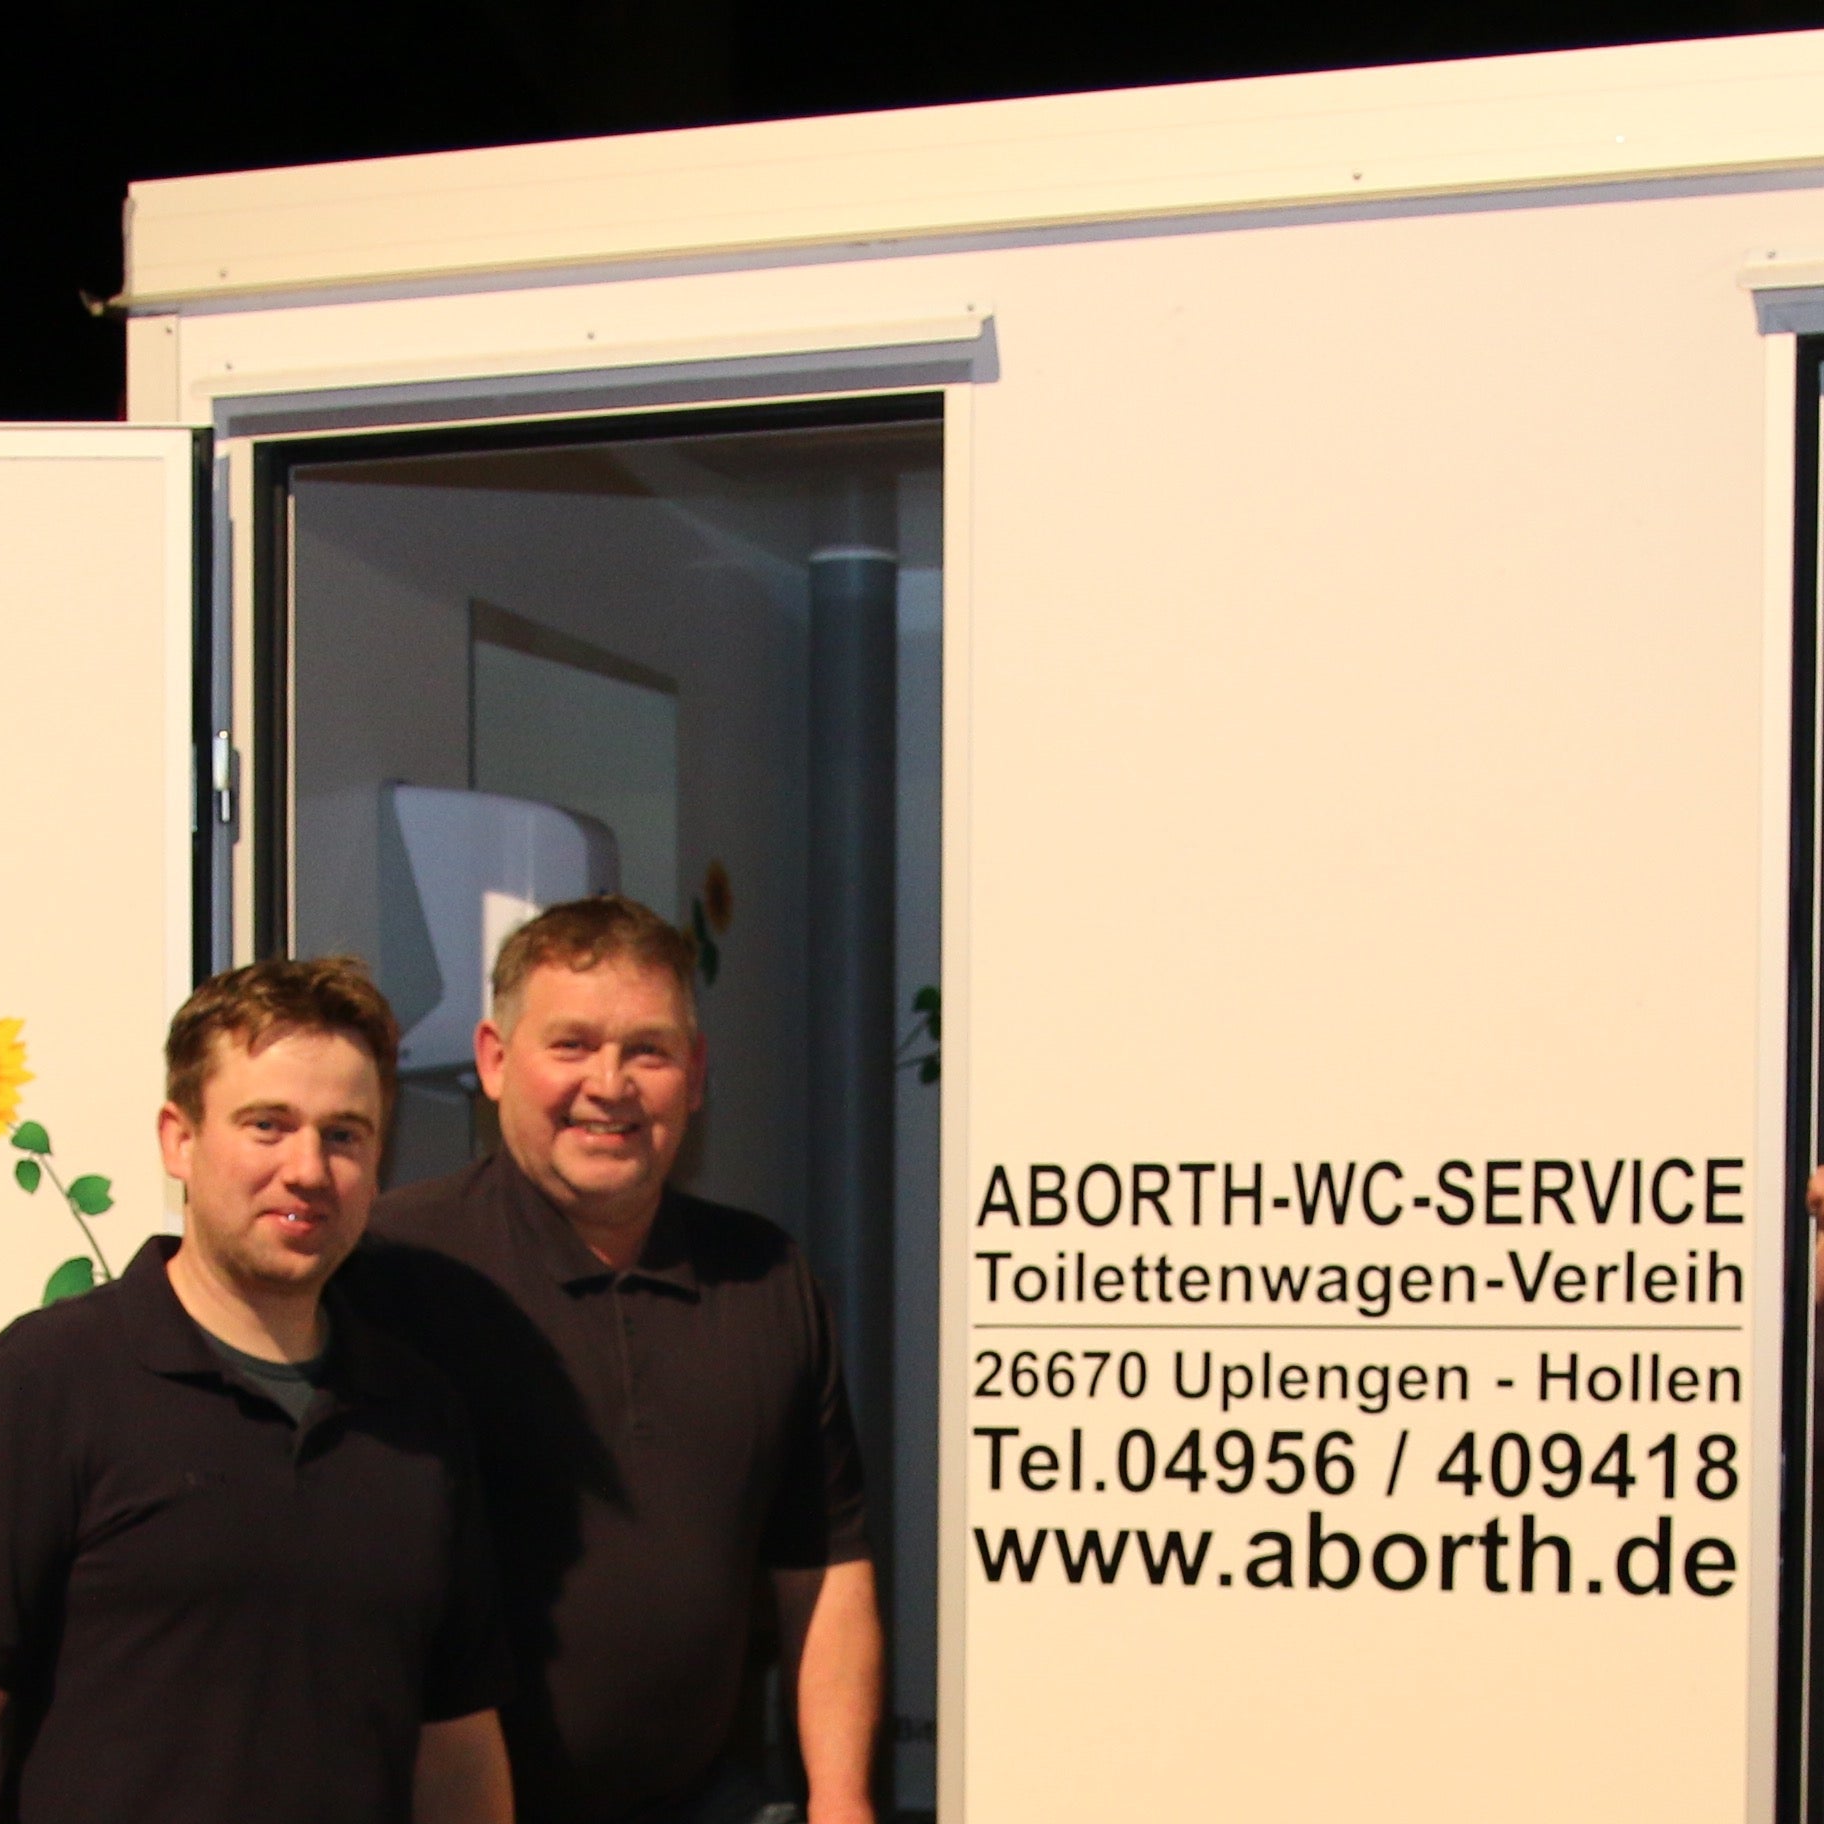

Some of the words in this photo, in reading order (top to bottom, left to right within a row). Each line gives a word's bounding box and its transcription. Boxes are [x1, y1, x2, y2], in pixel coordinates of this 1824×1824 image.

[977, 1158, 1744, 1228] ABORTH-WC-SERVICE
[975, 1250, 1743, 1318] Toilettenwagen-Verleih
[974, 1350, 1147, 1399] 26670
[1175, 1351, 1468, 1414] Uplengen
[1539, 1352, 1741, 1403] Hollen
[973, 1427, 1355, 1496] Tel.04956
[1386, 1429, 1409, 1497] /
[1437, 1431, 1738, 1501] 409418
[973, 1510, 1737, 1598] www.aborth.de
